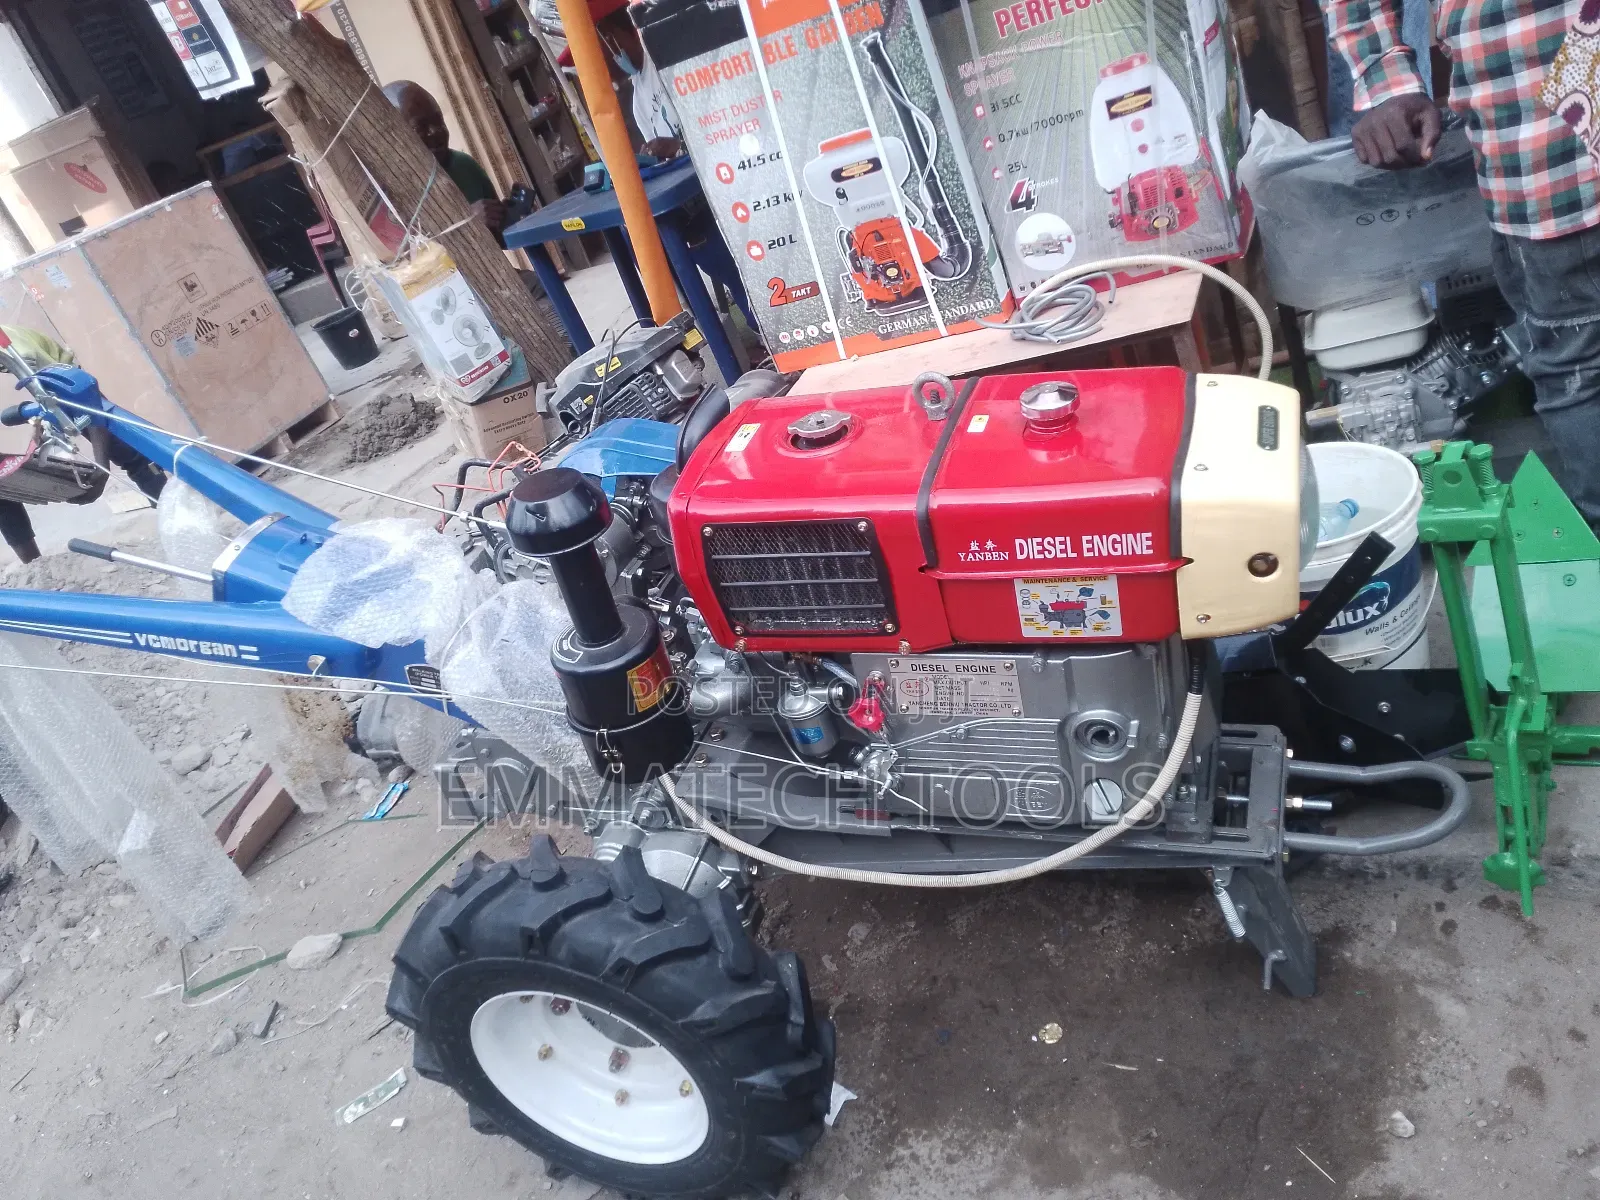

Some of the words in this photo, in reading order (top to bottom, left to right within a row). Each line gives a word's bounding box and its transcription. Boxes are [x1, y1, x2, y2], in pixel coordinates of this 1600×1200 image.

[993, 0, 1103, 39] PERFE
[1020, 30, 1065, 53] POWER
[673, 33, 799, 97] COMFORTBLE
[963, 67, 1017, 97] SPAYER
[697, 108, 729, 128] MIST
[731, 89, 783, 116] DUSTR
[705, 117, 762, 146] SPRAYER
[737, 153, 766, 171] 41.5
[1007, 160, 1028, 174] 25L
[752, 195, 781, 212] 2.13
[1004, 176, 1039, 214] 4
[767, 236, 787, 250] 20
[788, 234, 797, 244] L
[767, 276, 788, 307] 2
[790, 286, 812, 299] TAKT
[878, 315, 929, 335] GERMAN
[958, 551, 1010, 562] YANBEN
[1014, 536, 1078, 560] DIESEL
[1081, 532, 1154, 557] ENGINE
[1023, 577, 1070, 585] MAINTENANCE
[1079, 575, 1109, 583] SERVICE
[1325, 602, 1380, 629] lux
[1365, 621, 1390, 636] Walls
[910, 663, 950, 673] DIESEL
[955, 665, 997, 674] ENGINE
